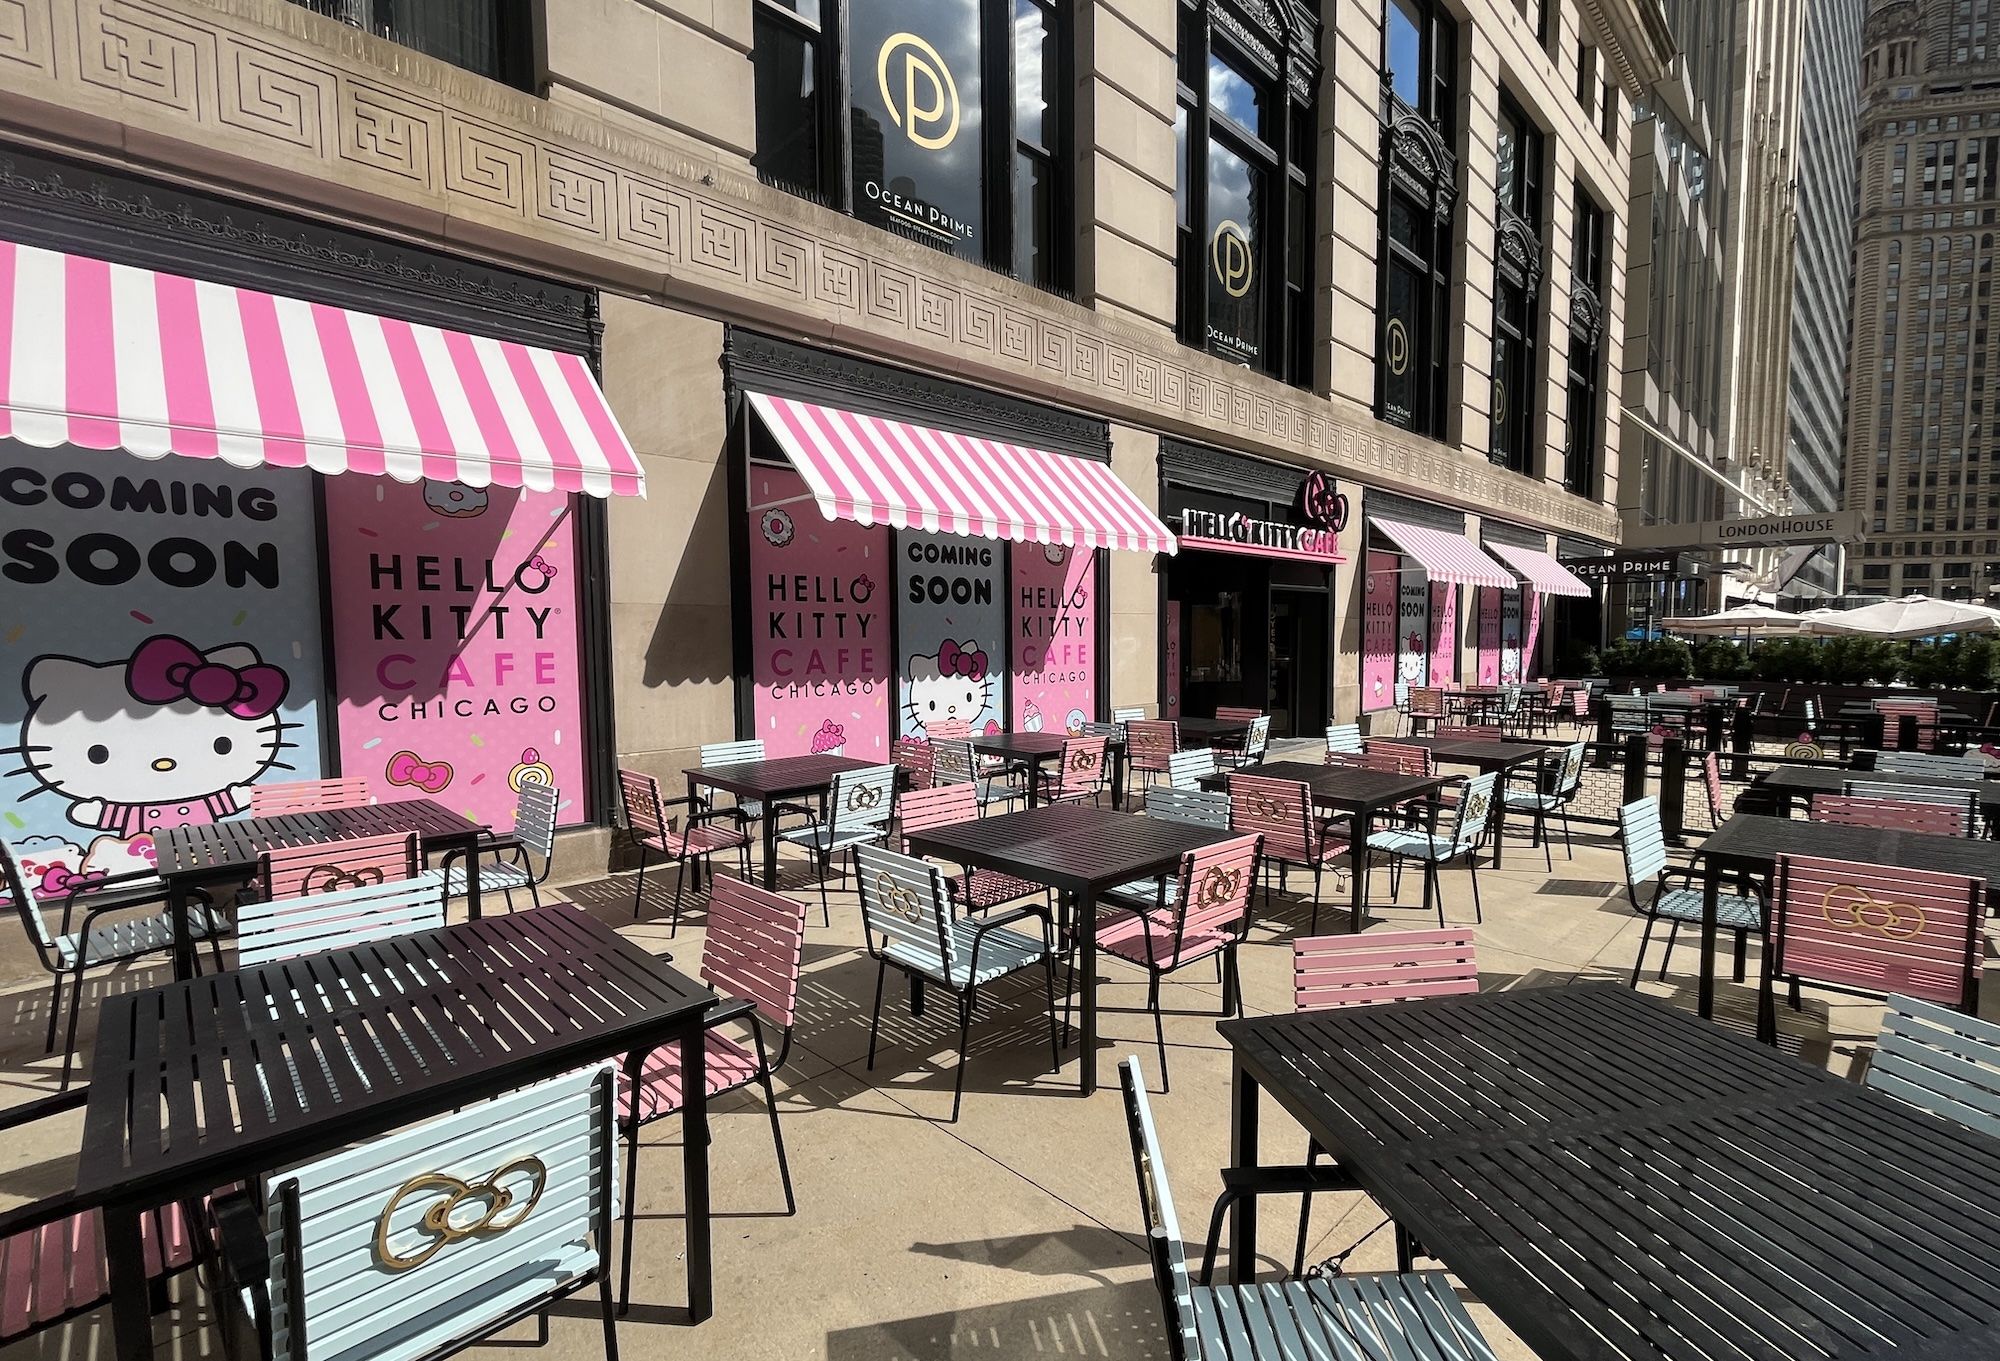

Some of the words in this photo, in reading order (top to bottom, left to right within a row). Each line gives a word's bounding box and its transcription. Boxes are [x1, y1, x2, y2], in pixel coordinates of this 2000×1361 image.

[865, 181, 923, 216] OCEAN
[929, 207, 974, 238] PRIME
[1235, 337, 1258, 355] PRIME
[0, 467, 278, 521] COMING
[1184, 510, 1248, 543] HELLO
[1250, 521, 1299, 550] KITTY
[1299, 529, 1339, 555] CAFE
[1718, 518, 1835, 538] LONDONHOUSE
[2, 529, 279, 589] SOON
[907, 542, 992, 567] COMING
[369, 553, 558, 595] HELLO
[1565, 563, 1617, 575] OCEAN
[1623, 561, 1670, 573] PRIME
[768, 573, 876, 603] HELLO
[909, 575, 992, 605] SOON
[1021, 585, 1088, 609] HELLO
[1402, 585, 1425, 597] COMING
[1366, 601, 1393, 617] HELLO
[1402, 602, 1425, 617] SOON
[1366, 621, 1391, 634] KITTY
[1022, 644, 1086, 667] CAFE
[1366, 638, 1391, 652] CAFE
[376, 652, 556, 691] CAFE
[771, 648, 873, 677] CAFE
[771, 681, 873, 699] CHICAGO
[1022, 671, 1086, 685] CHICAGO
[378, 696, 556, 721] CHICAGO
